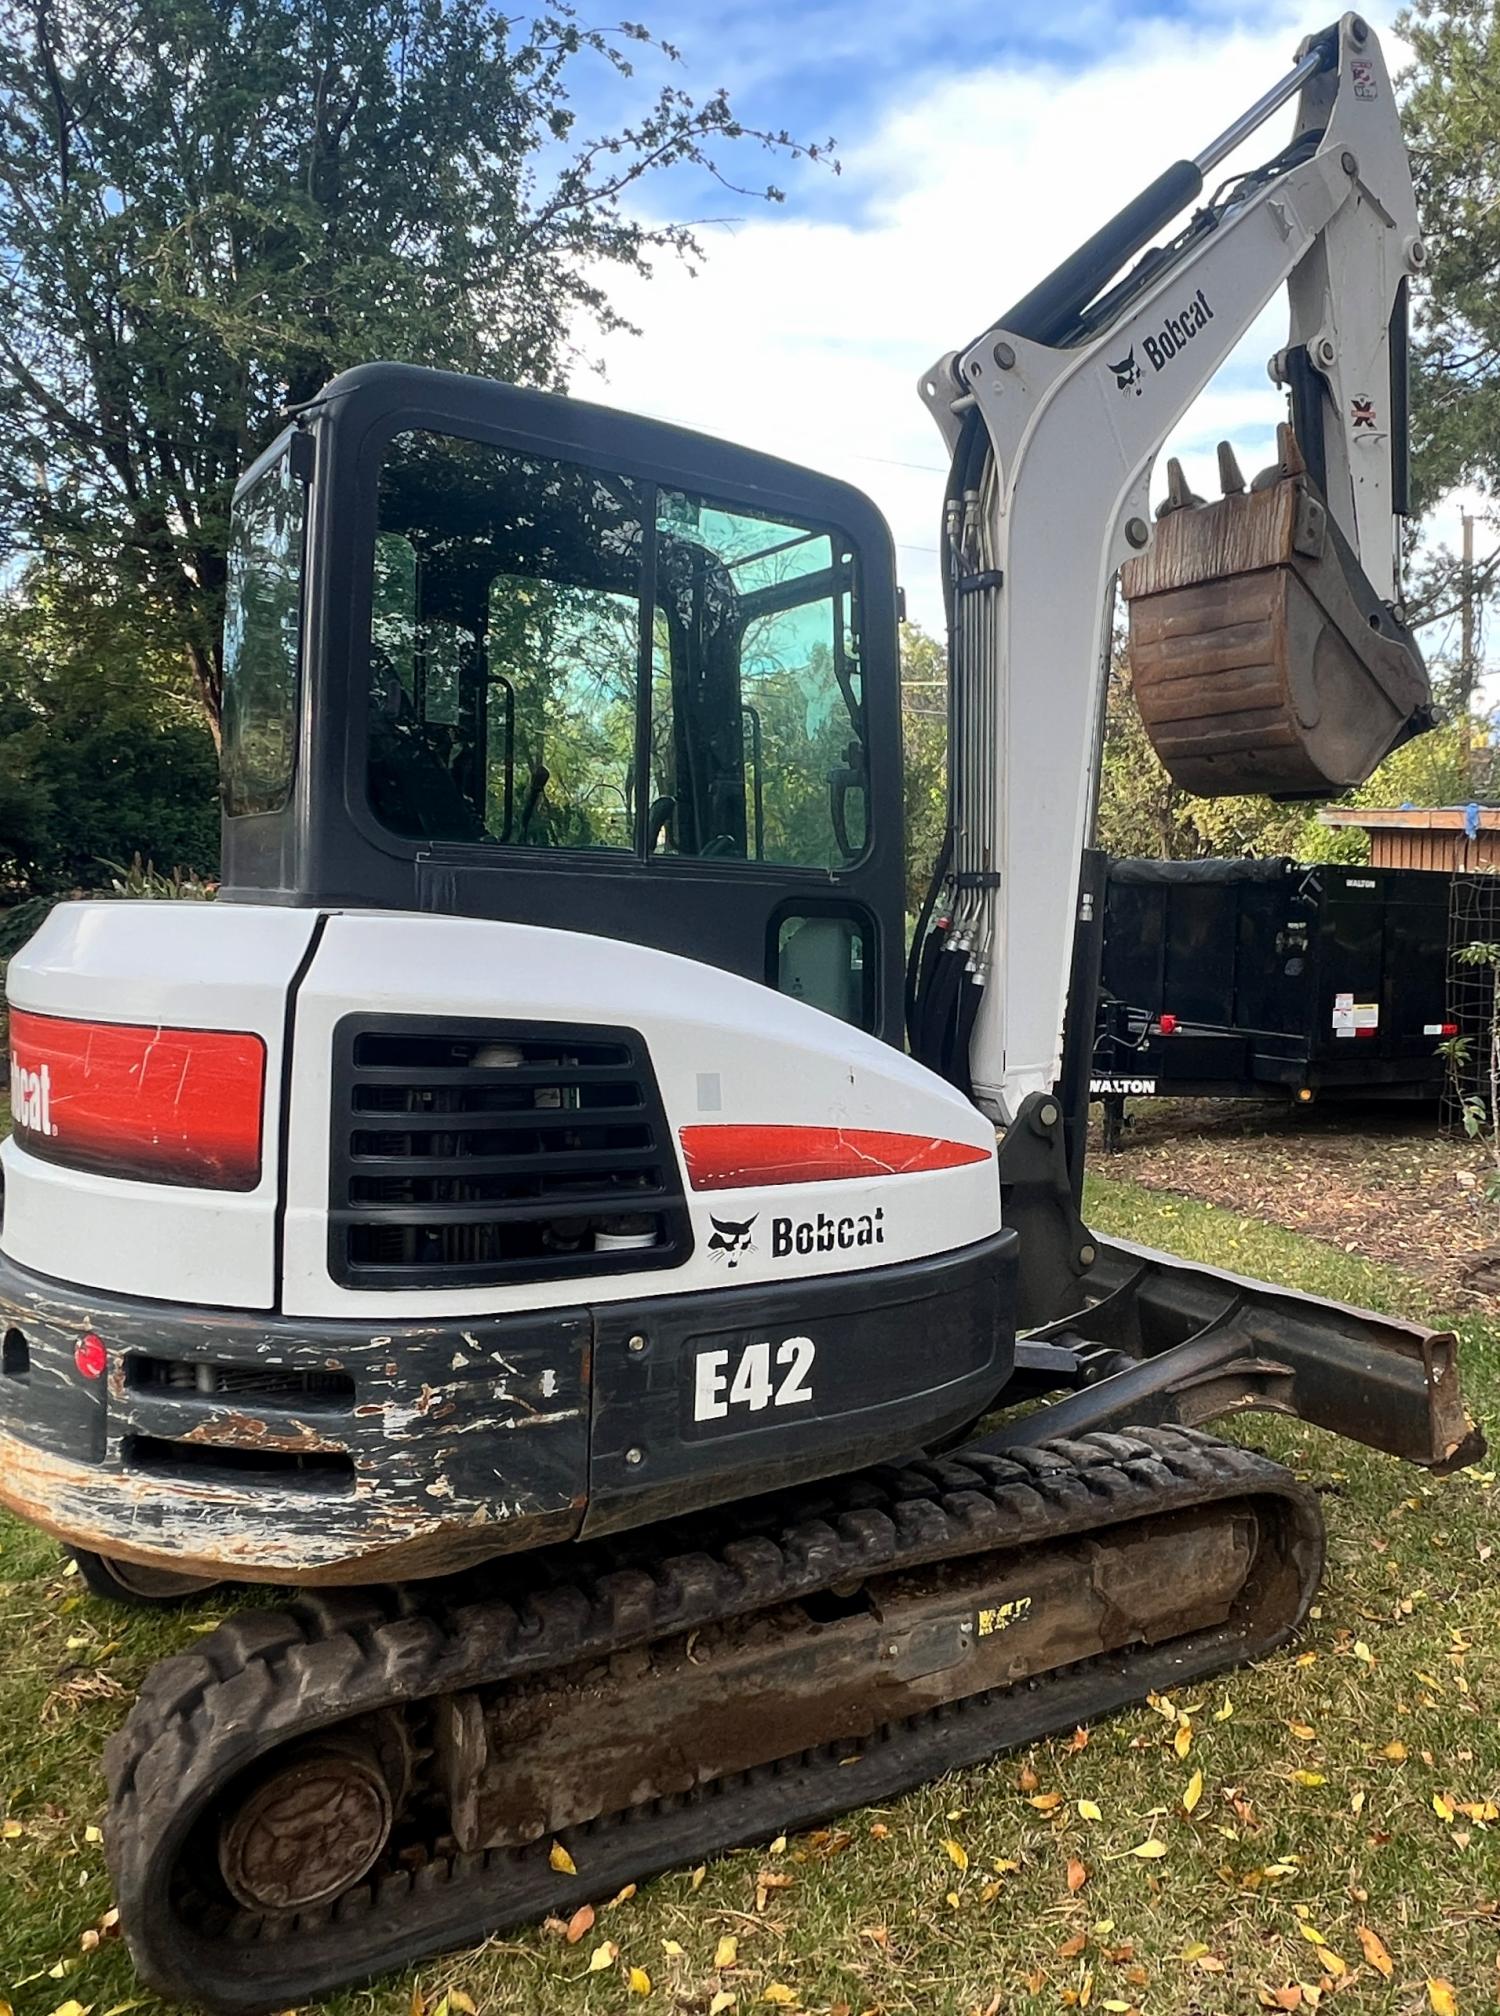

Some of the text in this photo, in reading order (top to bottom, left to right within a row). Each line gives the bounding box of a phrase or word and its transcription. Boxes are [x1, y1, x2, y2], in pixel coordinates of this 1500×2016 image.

[1142, 289, 1214, 372] Bobcat
[1346, 879, 1375, 888] WALTON
[772, 1207, 884, 1258] Bobcat
[694, 1336, 816, 1422] E42
